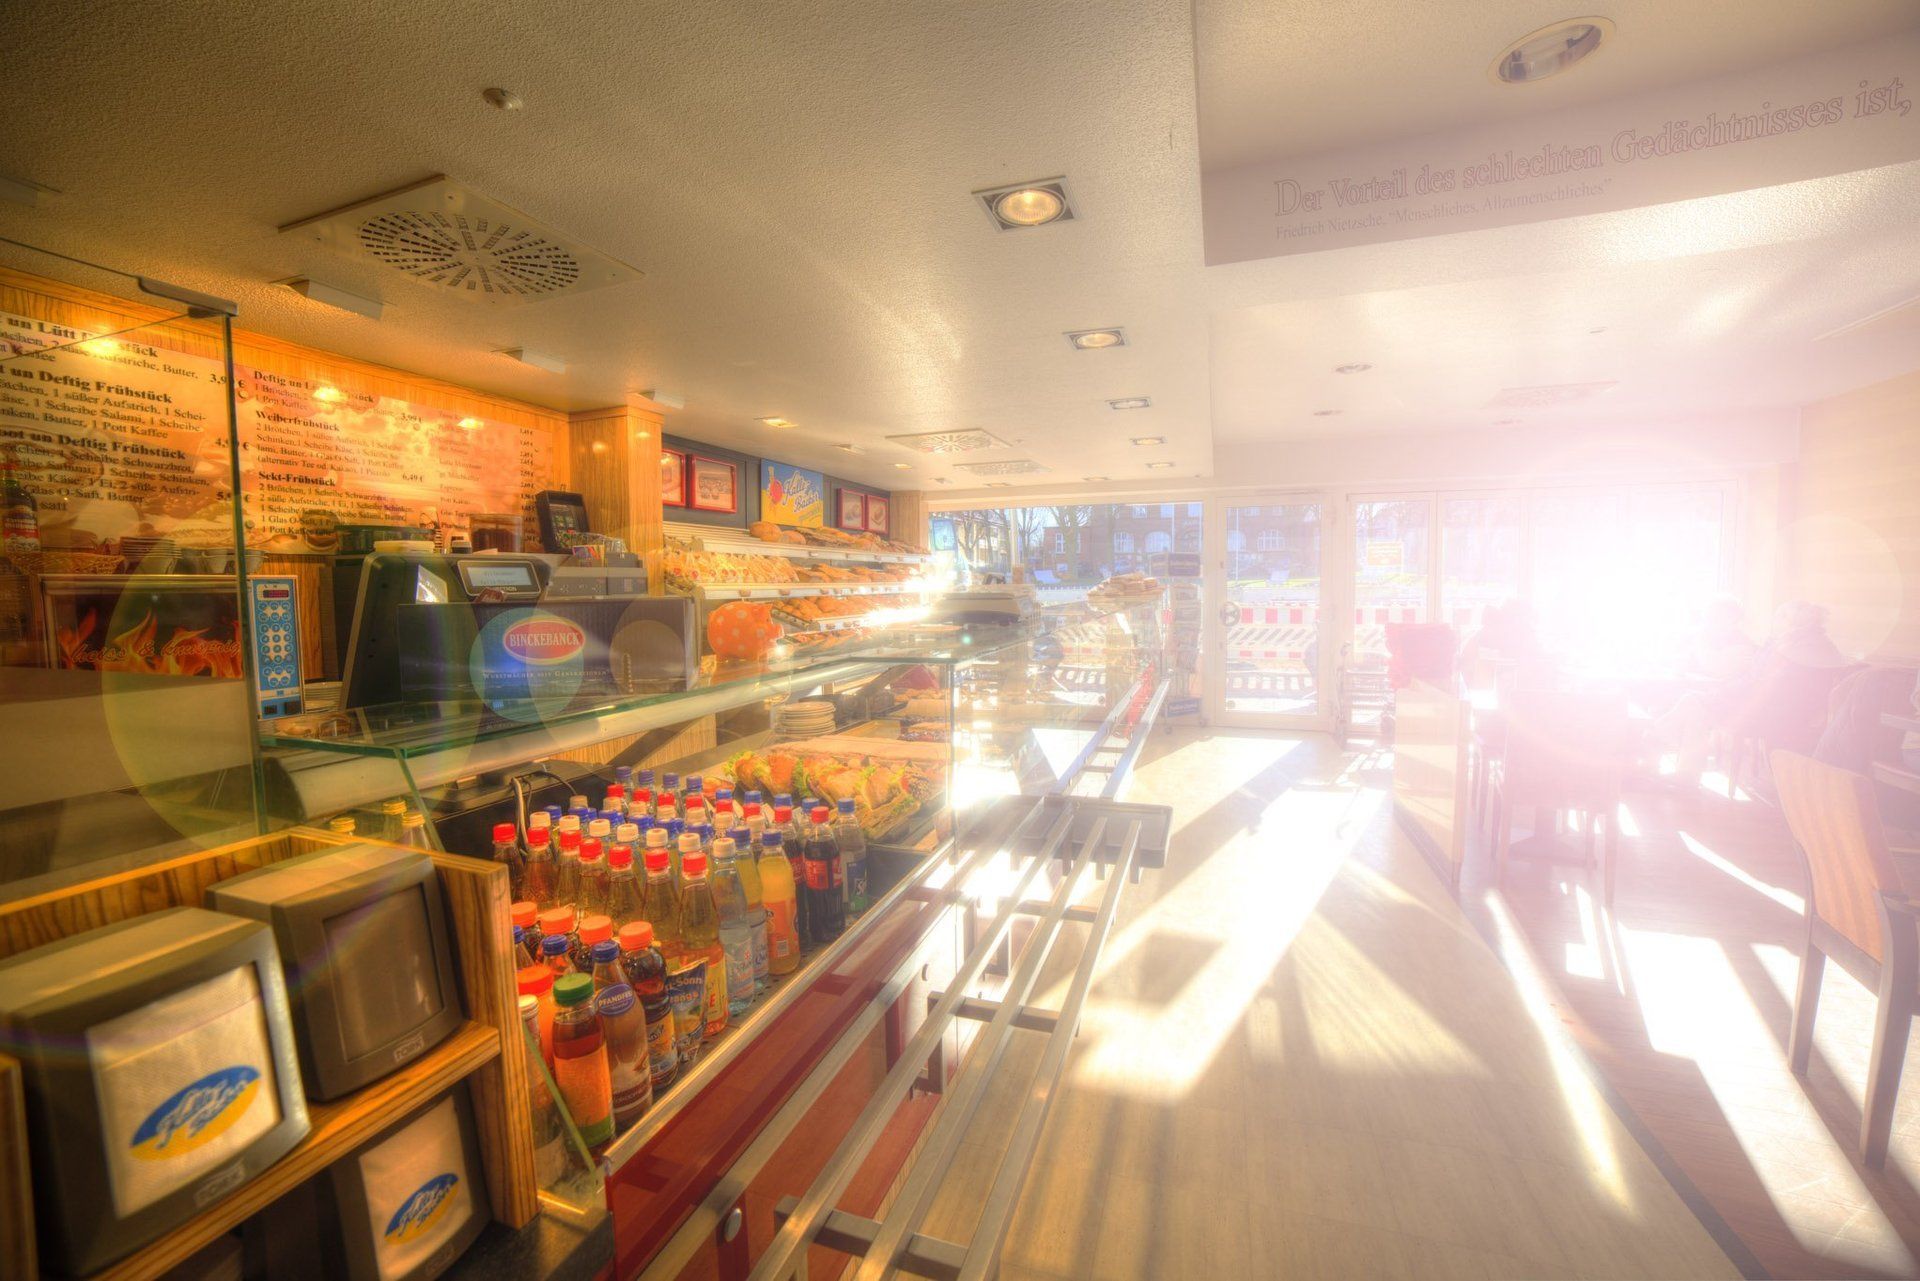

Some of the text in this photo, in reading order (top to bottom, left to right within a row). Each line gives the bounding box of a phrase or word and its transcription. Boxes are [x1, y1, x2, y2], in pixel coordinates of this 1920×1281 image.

[1274, 77, 1912, 216] Der Vorteil des schlechten Gedächtnisses ist,
[10, 367, 173, 404] un Deftig Frühstück
[254, 370, 287, 387] Deftig
[45, 400, 98, 416] Scheibe
[159, 418, 201, 432] Scheibe
[102, 421, 127, 434] Pott
[130, 425, 169, 439] Kaffee
[30, 432, 52, 444] un
[57, 434, 108, 452] Deftig
[112, 441, 186, 460] Frühstück
[258, 470, 336, 487] Sekt-Frühstück
[509, 632, 580, 648] BINCKEBANCK
